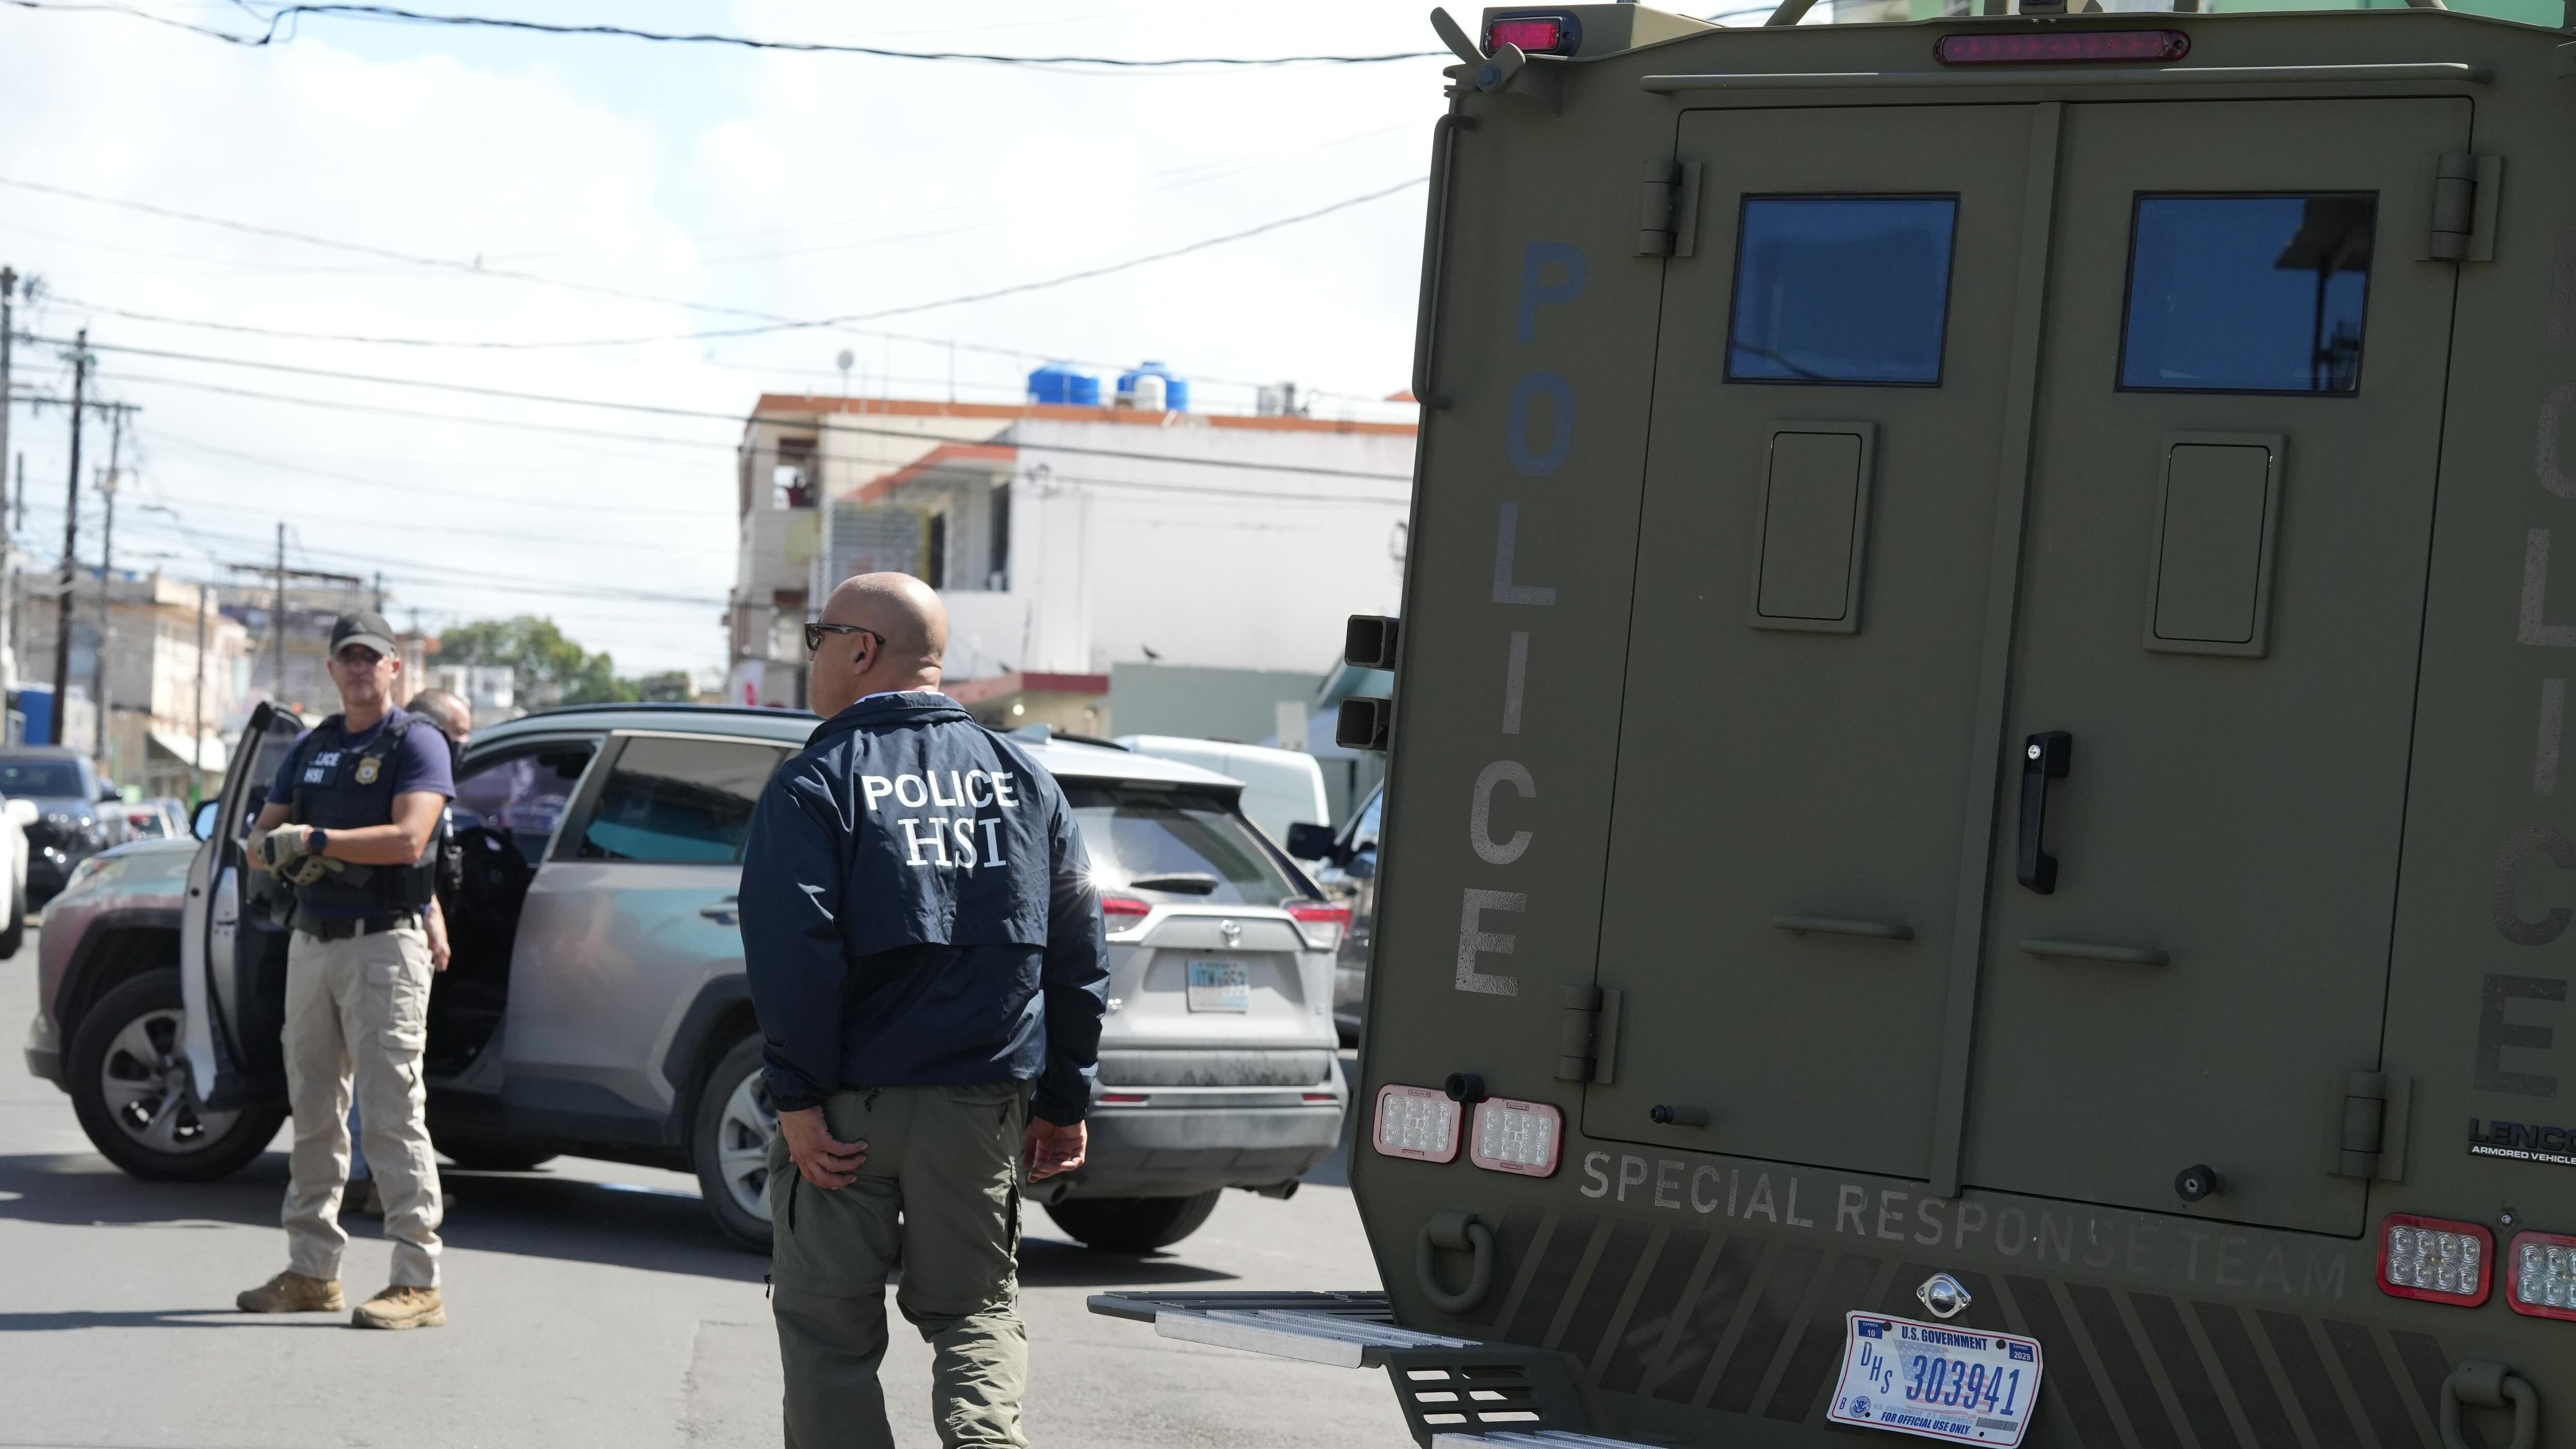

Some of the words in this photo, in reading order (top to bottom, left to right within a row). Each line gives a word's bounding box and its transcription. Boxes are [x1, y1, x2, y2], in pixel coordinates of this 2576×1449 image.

[1455, 241, 1589, 996] POLICE
[861, 770, 1019, 810] POLICE
[897, 817, 1007, 868] HSI
[2472, 1146, 2529, 1159] ARMORED
[1580, 1151, 1813, 1228] SPECIAL
[1836, 1184, 2157, 1275] RESPONSE
[2180, 1230, 2347, 1300] TEAM
[1902, 1326, 1919, 1340] U.S.
[1921, 1329, 1988, 1351] GOVERNMENT
[2014, 1351, 2030, 1360] 2029
[1906, 1354, 2020, 1416] 303941
[1839, 1397, 1846, 1409] B
[1881, 1411, 1897, 1422] FOR
[1897, 1414, 1931, 1429] OFFICIAL
[1933, 1420, 1949, 1431] USE
[1949, 1423, 1971, 1435] ONLY
